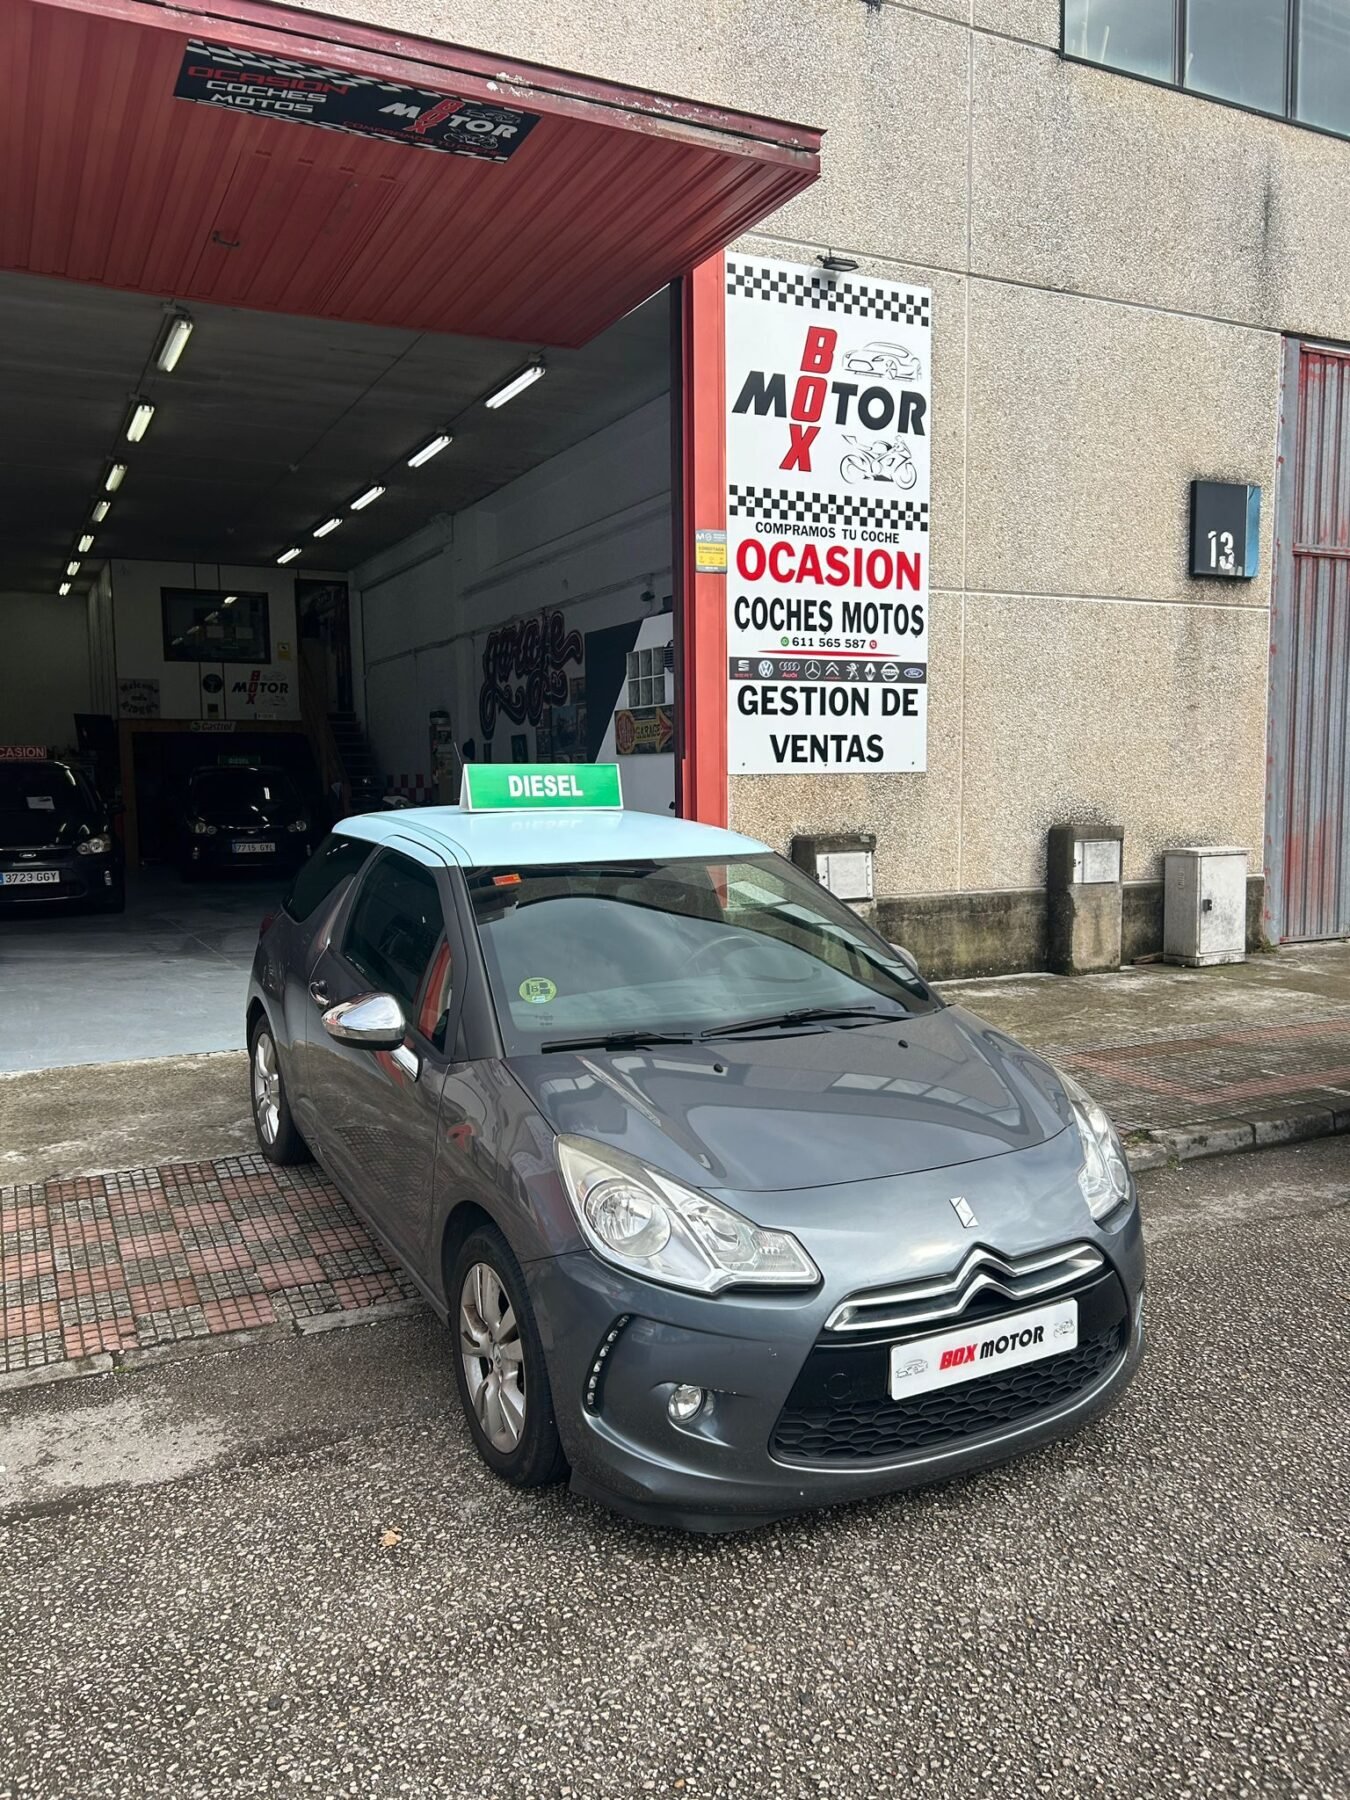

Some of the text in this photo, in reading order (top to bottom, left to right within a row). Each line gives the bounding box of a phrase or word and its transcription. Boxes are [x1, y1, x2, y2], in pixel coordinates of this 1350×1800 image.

[188, 65, 351, 96] OCASION
[206, 80, 329, 103] COCHES
[210, 93, 314, 114] MOTOS
[403, 98, 466, 136] BOX
[731, 370, 927, 436] MOTOR
[779, 325, 838, 473] BOX
[755, 521, 900, 544] COMPRAMOS TU COCHE
[736, 538, 921, 591] OCASION
[1207, 530, 1235, 570] 13
[734, 595, 925, 637] COCHES MOTOS
[792, 637, 866, 649] 611 565 587
[737, 685, 919, 716] GESTION DE
[769, 734, 884, 763] VENTAS
[507, 775, 584, 798] DIESEL
[5, 871, 57, 884] 3723 GGY
[939, 1325, 1045, 1370] BOX MOTOR
